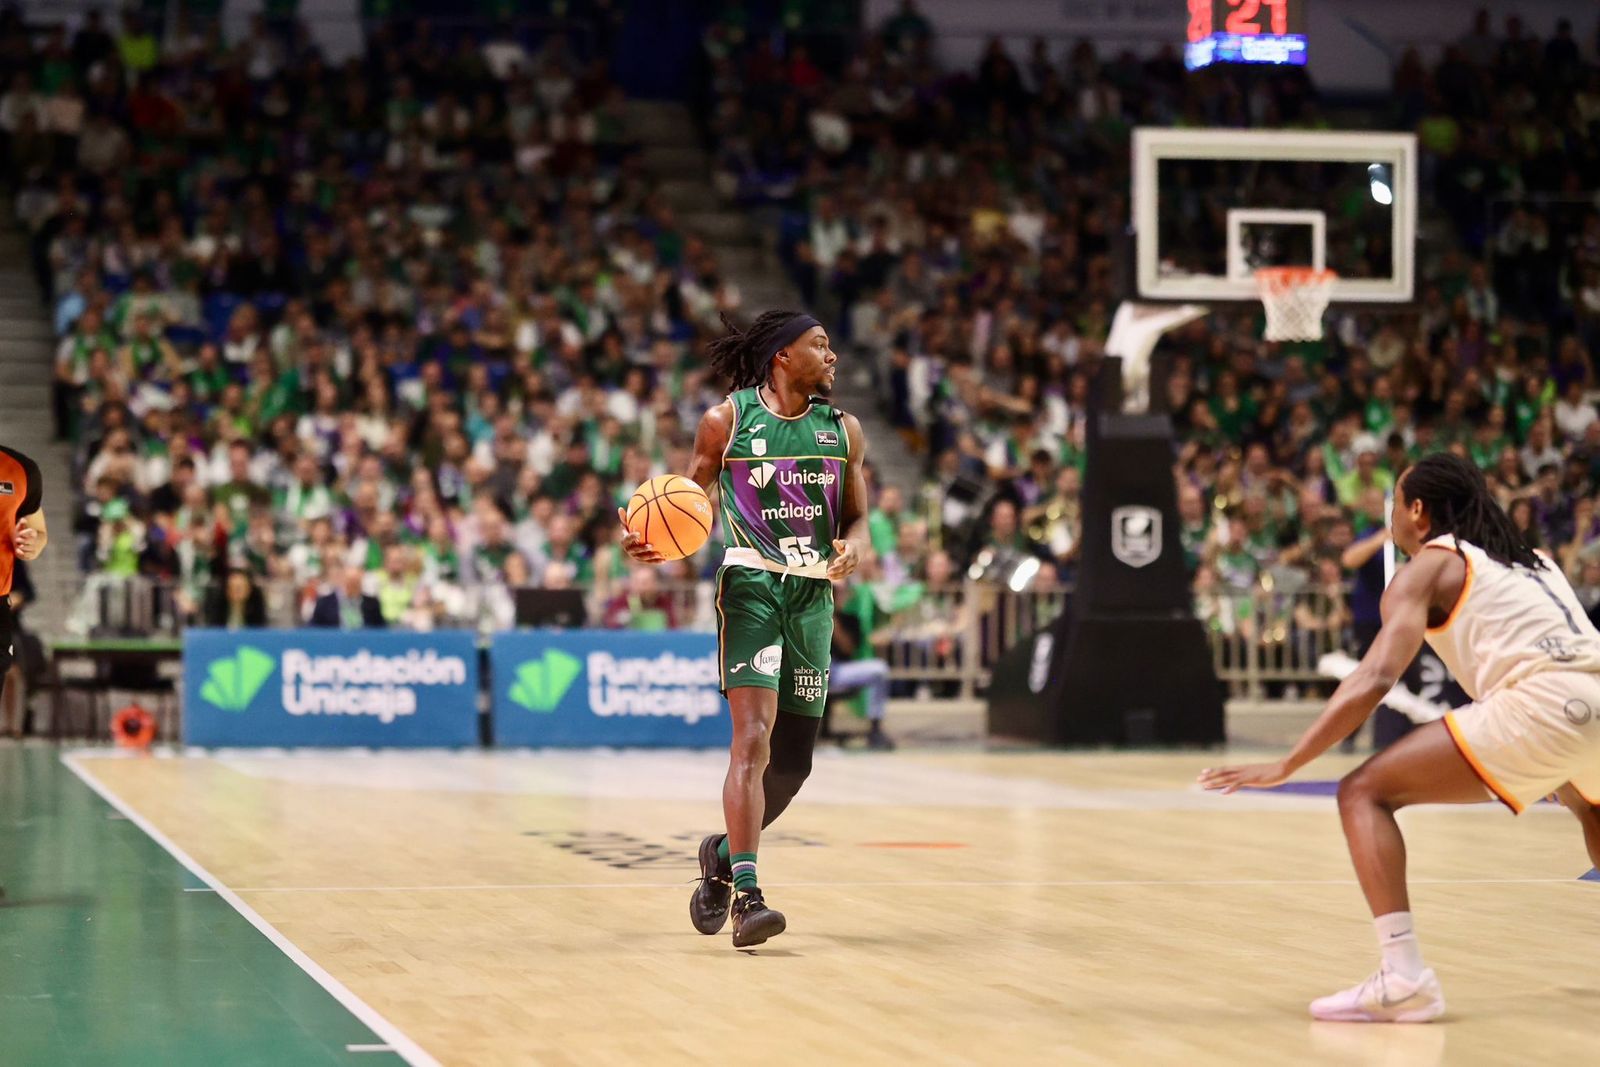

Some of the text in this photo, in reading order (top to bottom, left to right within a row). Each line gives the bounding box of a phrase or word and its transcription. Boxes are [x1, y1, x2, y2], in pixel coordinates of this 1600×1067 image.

[780, 469, 836, 489] Unicaja
[778, 536, 820, 567] 55
[282, 648, 466, 685] Fundación
[794, 666, 815, 674] sabor
[282, 683, 417, 724] Unicaja
[588, 683, 721, 725] Unicaja
[794, 683, 822, 702] laga
